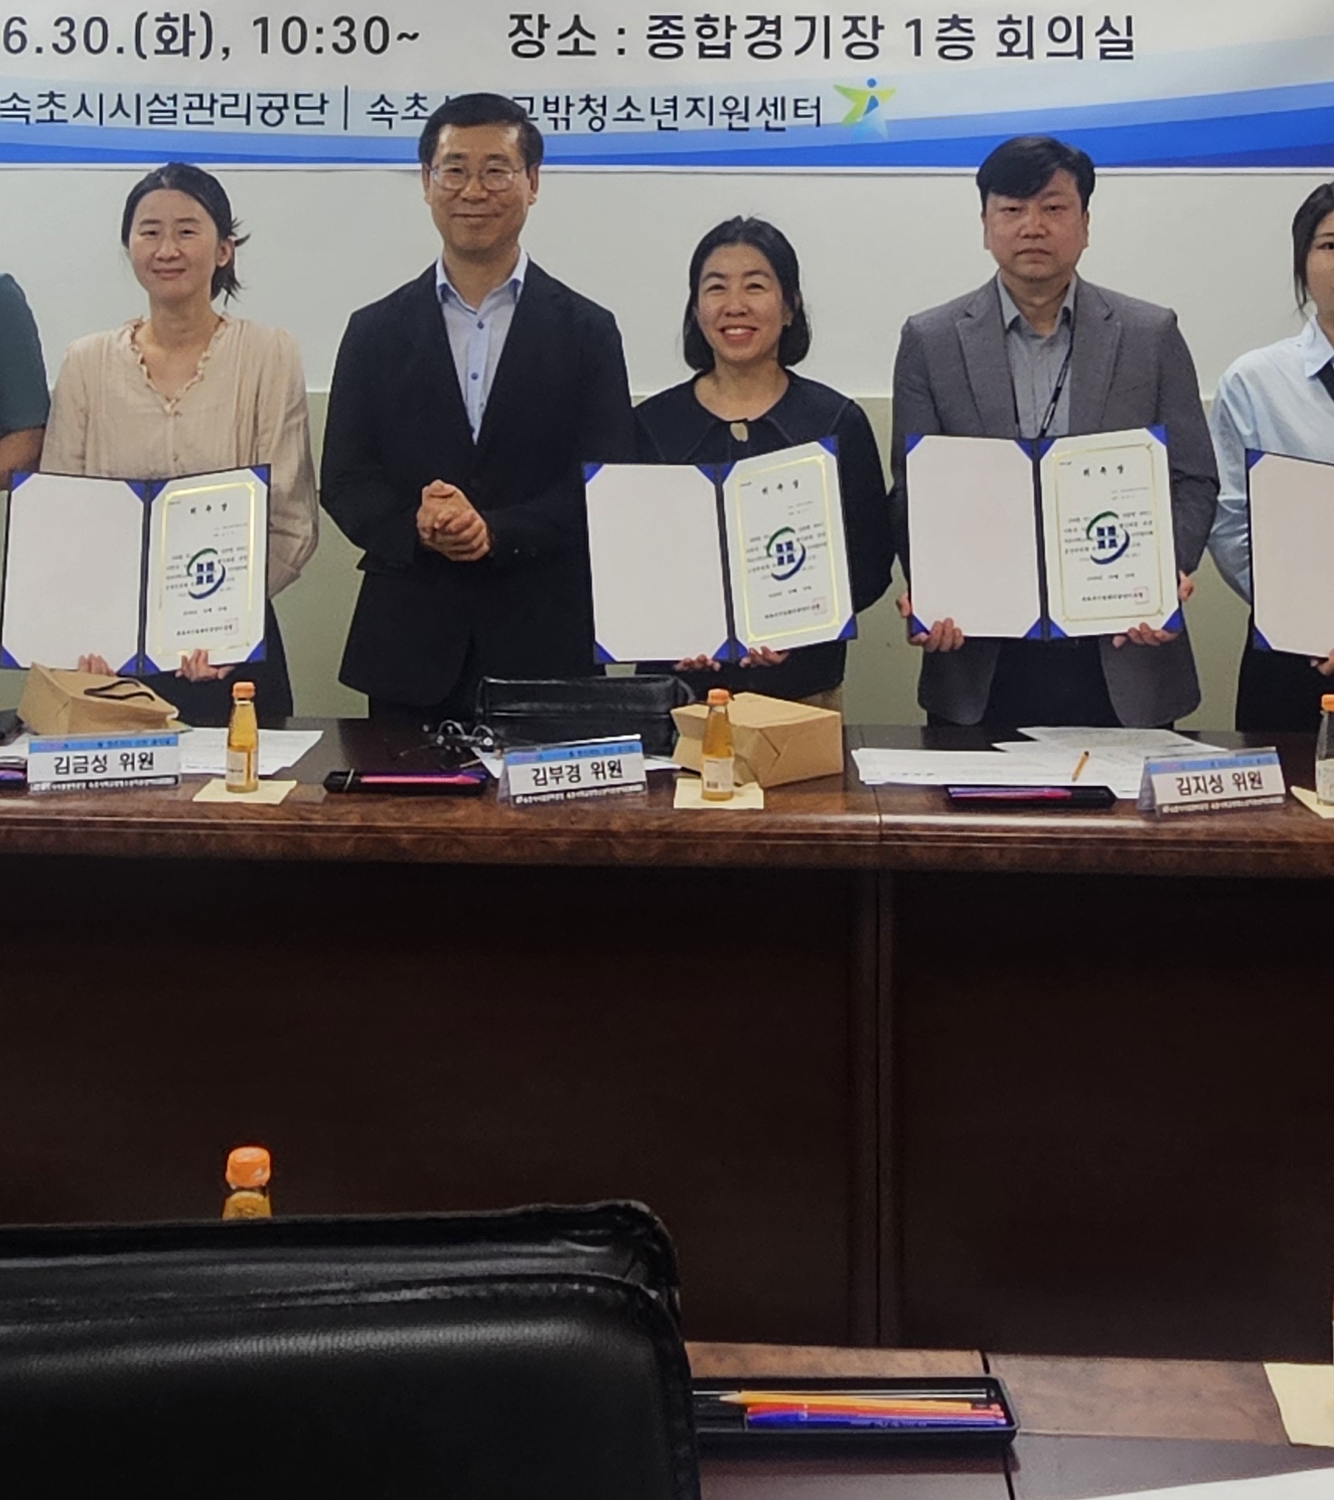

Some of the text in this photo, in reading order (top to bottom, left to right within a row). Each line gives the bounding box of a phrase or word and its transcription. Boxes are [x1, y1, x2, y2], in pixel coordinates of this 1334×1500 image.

[252, 14, 420, 56] 10:30~
[507, 13, 597, 59] 장소
[646, 13, 885, 60] 종합경기장
[905, 13, 976, 61] 1층
[996, 13, 1134, 61] 회의실
[366, 91, 821, 132] 속초밖청소년지원센터
[53, 751, 154, 776] 김금성 위원
[532, 759, 623, 787] 김부경 위원
[1231, 770, 1264, 792] 위원
